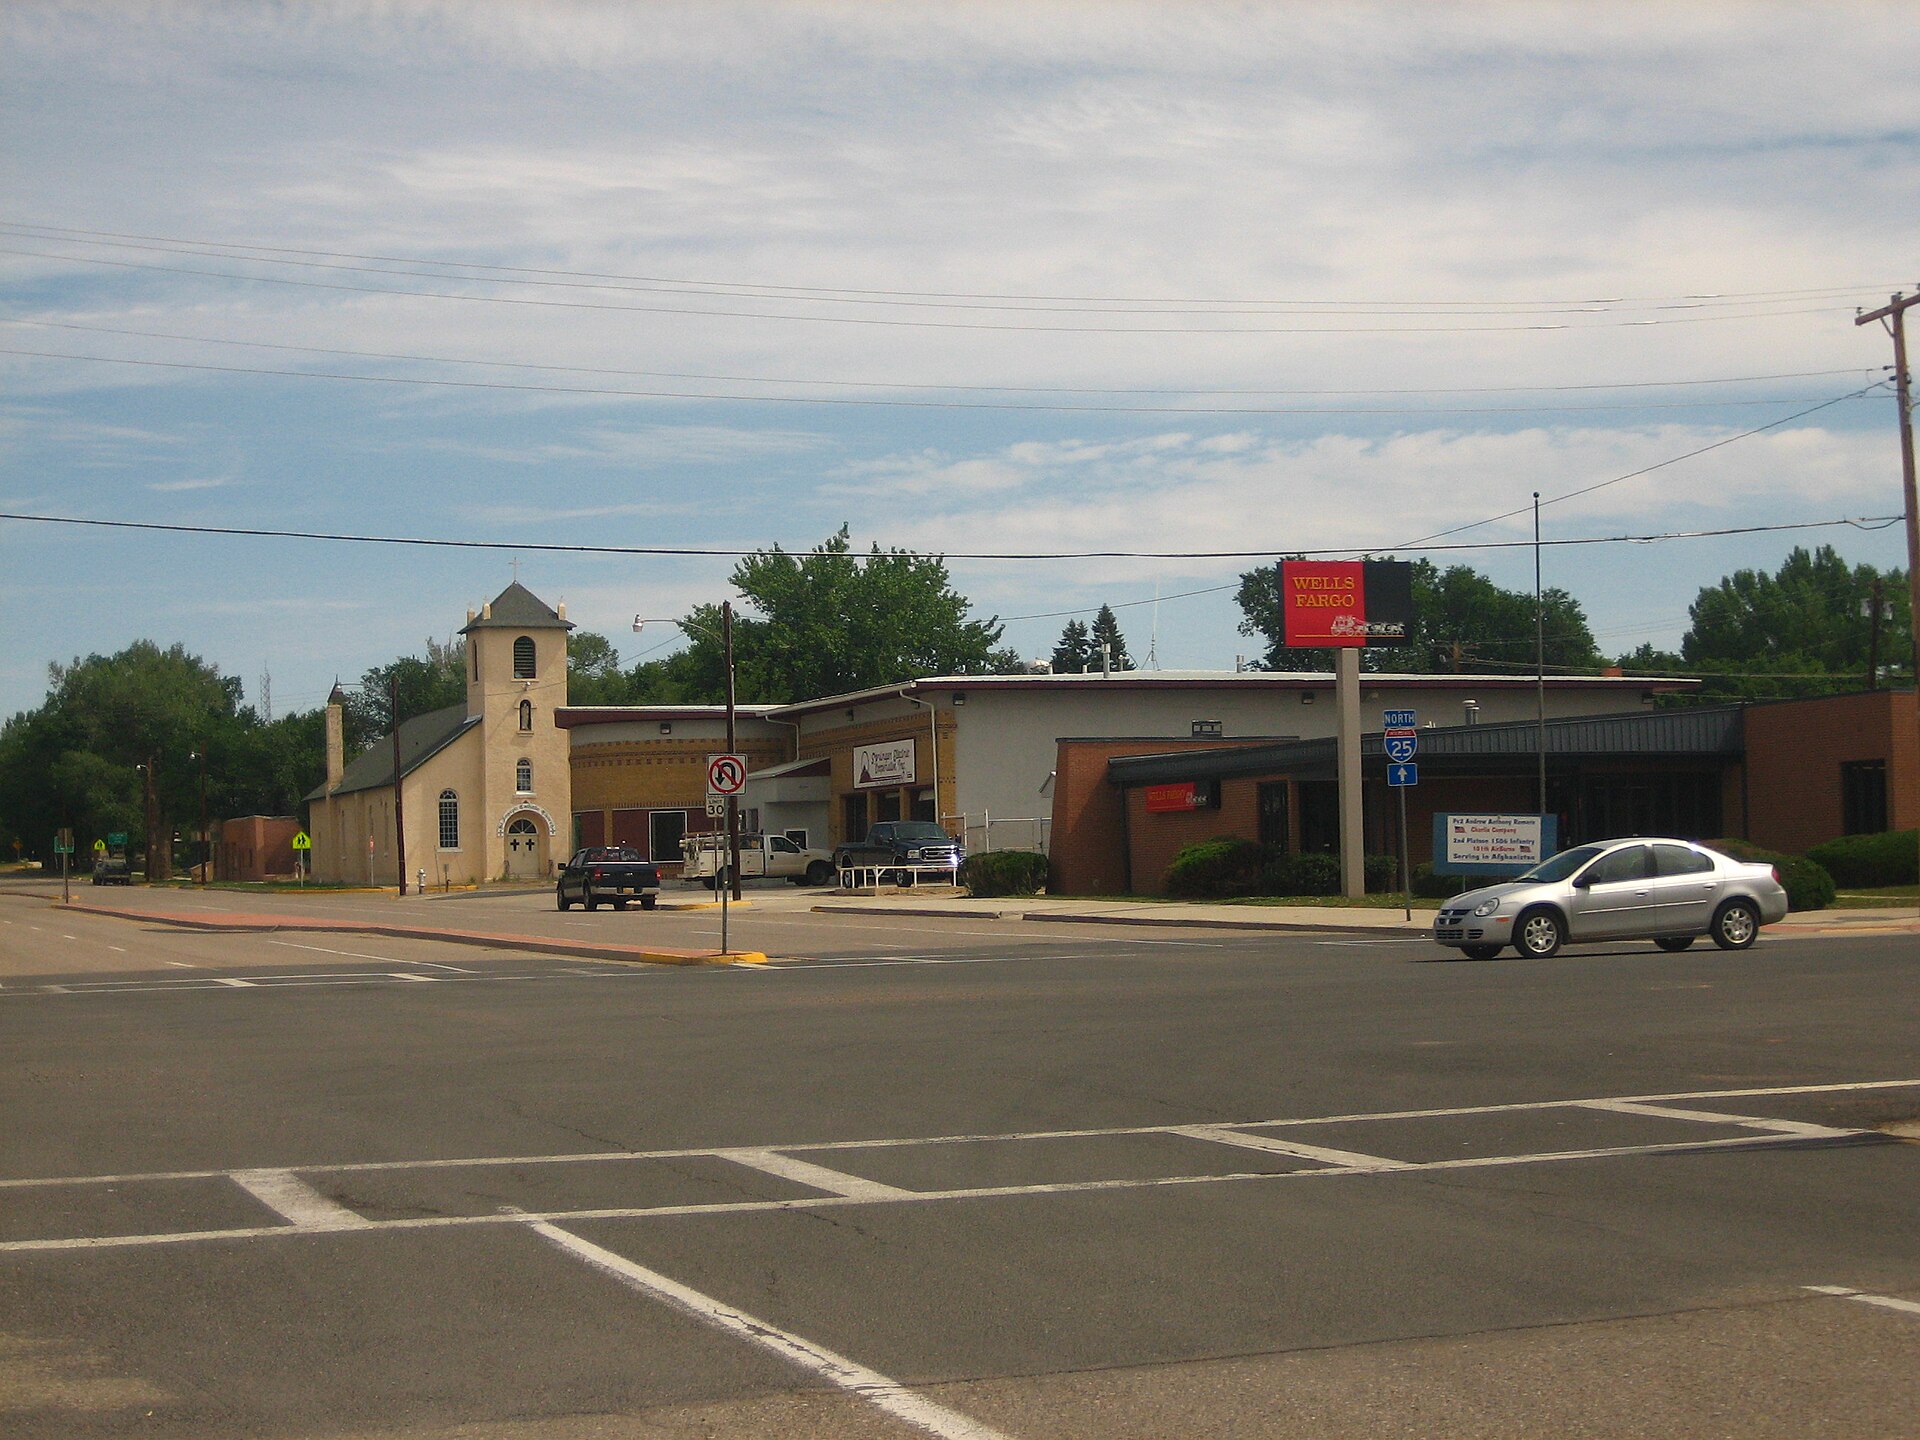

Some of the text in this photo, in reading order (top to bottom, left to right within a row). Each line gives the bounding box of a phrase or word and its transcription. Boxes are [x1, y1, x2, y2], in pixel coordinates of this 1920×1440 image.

[1292, 576, 1355, 590] WELLS
[1295, 594, 1355, 607] FARGO
[1384, 713, 1415, 724] NORTH
[1391, 741, 1412, 757] 25
[707, 805, 724, 815] 30
[1491, 853, 1535, 861] Afghanistan
